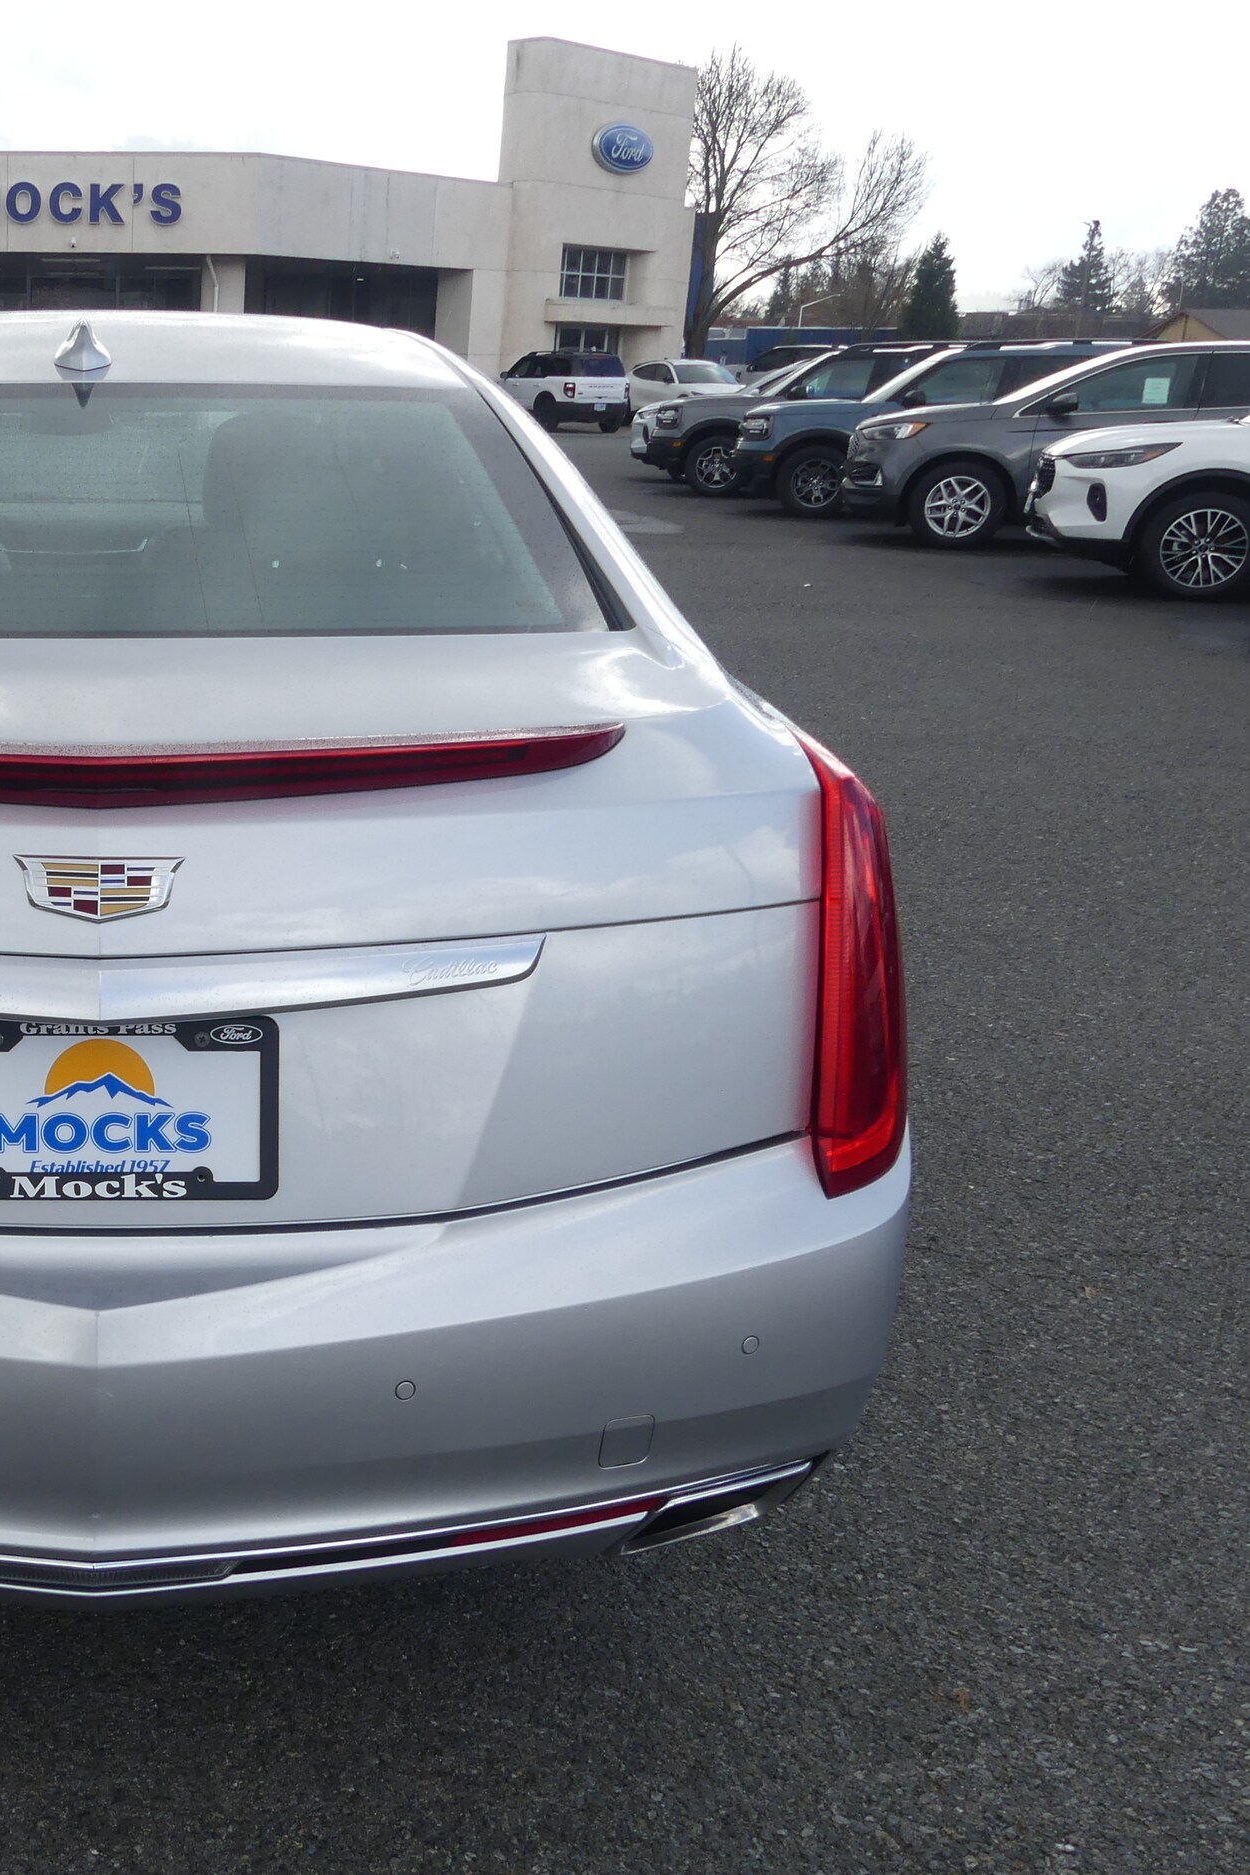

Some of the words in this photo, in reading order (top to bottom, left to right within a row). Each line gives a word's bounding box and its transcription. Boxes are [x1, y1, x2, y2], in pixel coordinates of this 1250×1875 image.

[611, 132, 645, 162] Ford
[401, 956, 498, 986] Cadillac
[19, 1022, 109, 1035] Grants
[219, 1026, 253, 1041] Ford
[30, 1159, 127, 1173] Established
[130, 1159, 171, 1173] 1957
[10, 1173, 187, 1198] Mock's
